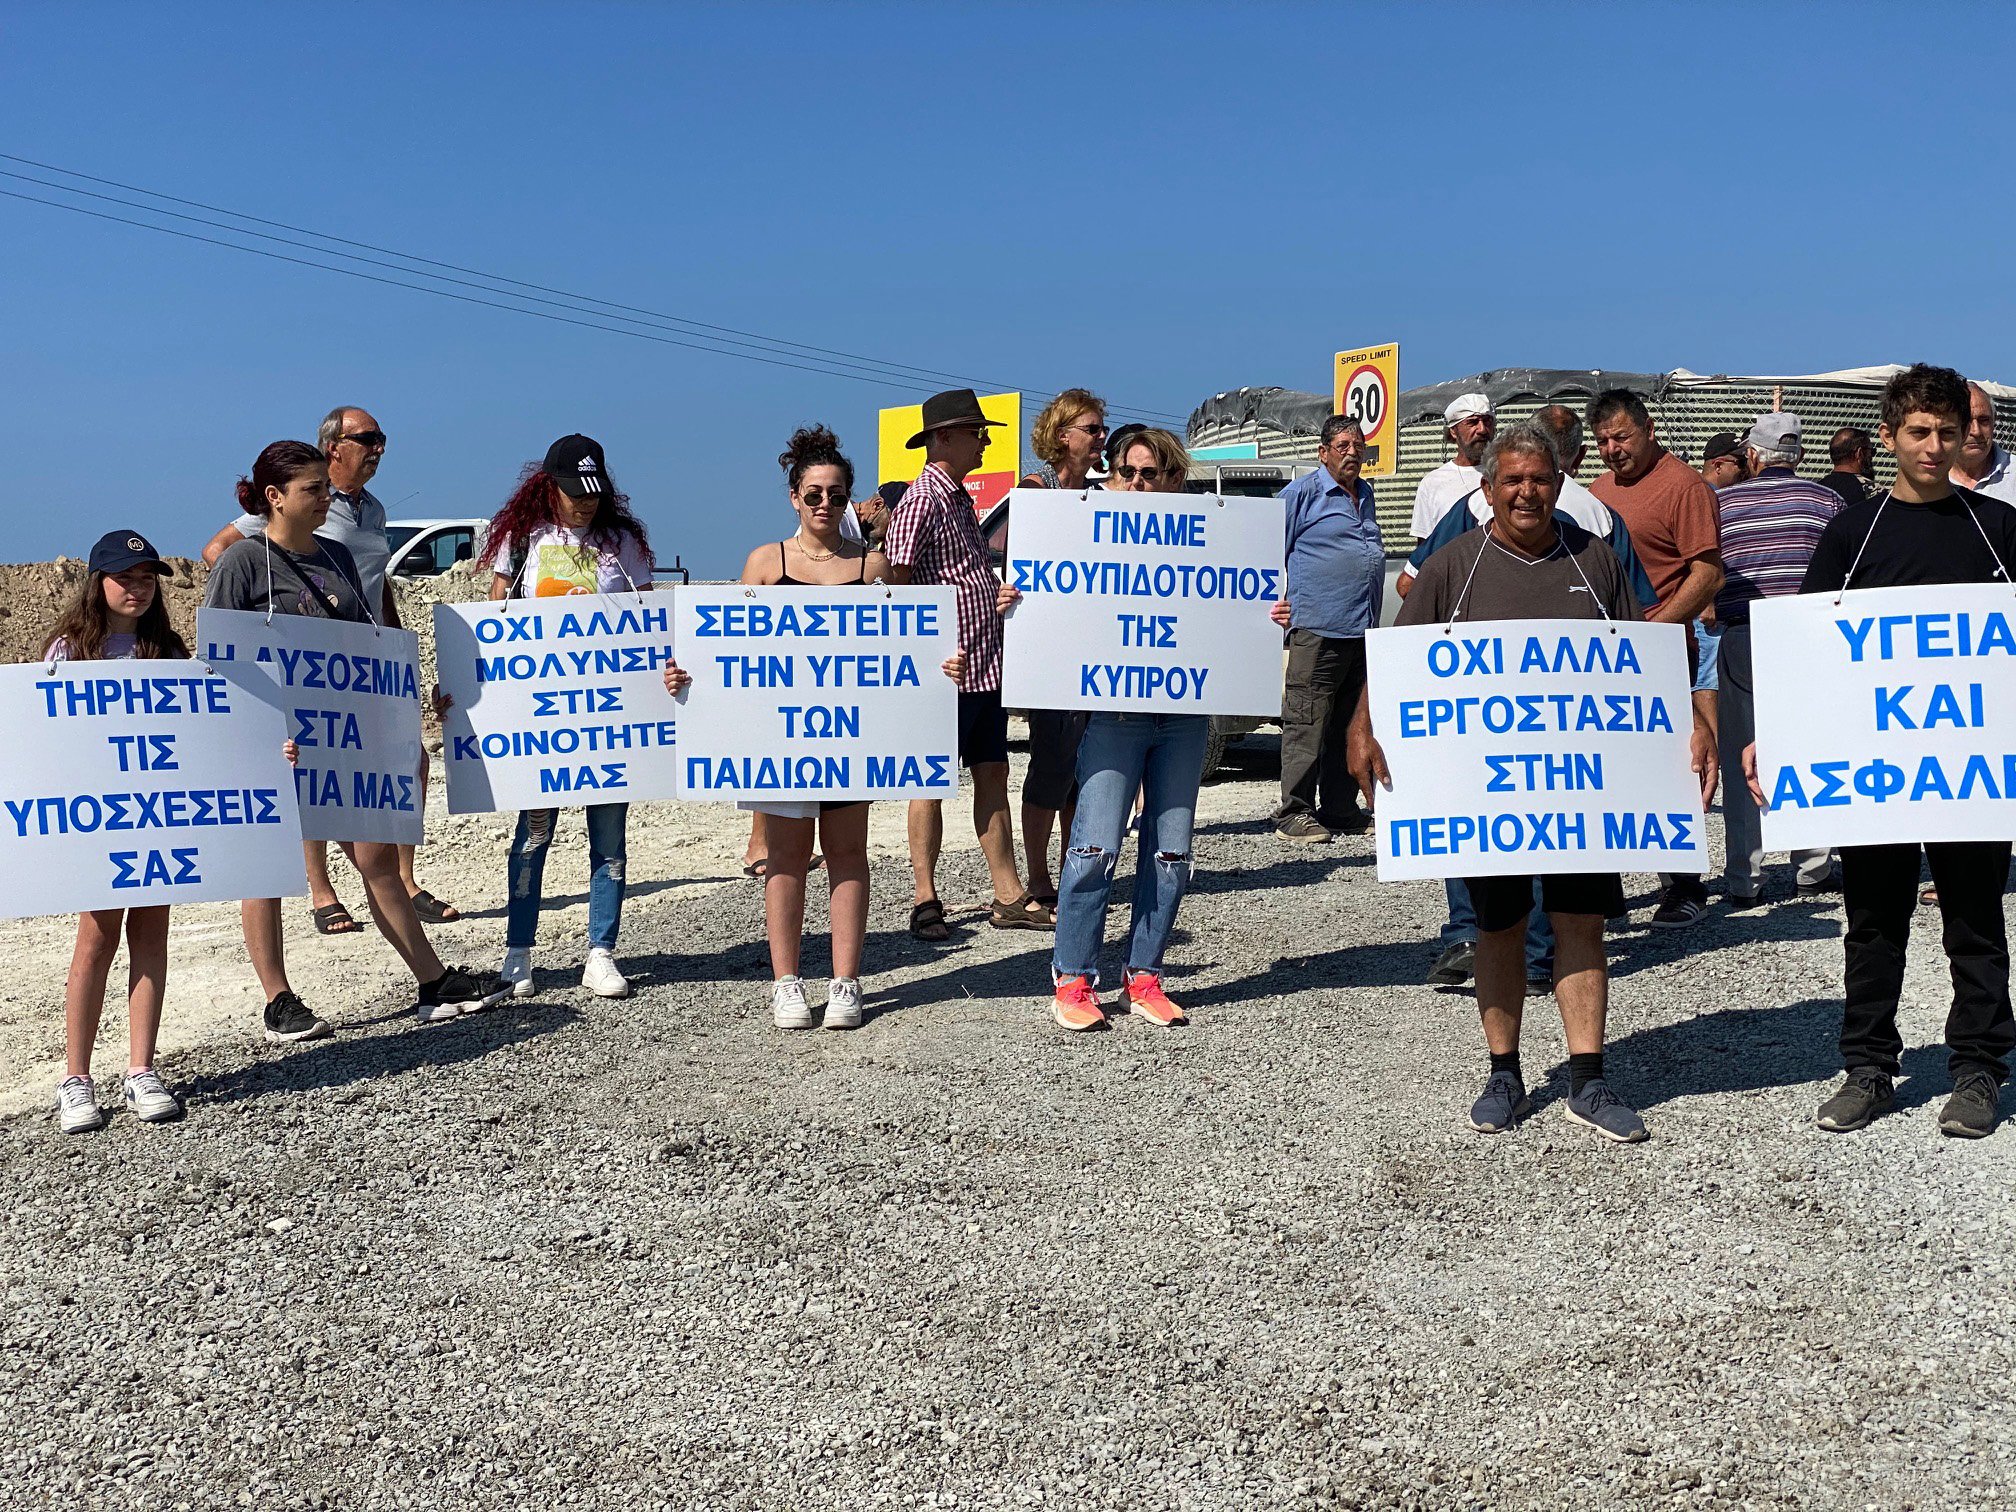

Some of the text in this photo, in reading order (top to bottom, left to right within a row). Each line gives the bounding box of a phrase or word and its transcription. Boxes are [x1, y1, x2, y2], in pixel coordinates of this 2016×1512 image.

[1341, 349, 1392, 365] SPEED LIMIT
[1350, 383, 1380, 424] 30
[1094, 511, 1206, 547] ΓΙΝΑΜΕ
[1013, 560, 1279, 601] ΣΚΟΥΠΙΔΟΤΟΠΟΣ
[475, 607, 668, 644] ΟΧΙ ΑΛΛΗ
[696, 604, 938, 637] ΣΕΒΑΣΤΕΙΤΕ
[1118, 614, 1178, 648] ΤΗΣ
[1835, 612, 2016, 662] ΥΓΕΙΑ
[475, 645, 673, 683] ΜΟΛΥΝΣΗ
[716, 655, 920, 688] ΤΗΝ ΥΓΕΙΑ
[1427, 636, 1642, 678] ΟΧΙ ΑΛΛΑ
[36, 678, 231, 718] ΤΗΡΗΣΤΕ
[1081, 664, 1209, 700] ΚΥΠΡΟΥ
[533, 687, 623, 717] ΣΤΙΣ
[1399, 694, 1673, 738] ΕΡΓΟΣΤΑΣΙΑ
[1875, 683, 1984, 731] ΚΑΙ
[294, 708, 363, 750] ΣΤΑ
[779, 706, 860, 738] ΤΩΝ
[108, 734, 179, 772] ΤΙΣ
[353, 771, 415, 812] ΜΑΣ
[541, 763, 628, 793] ΜΑΣ
[687, 756, 950, 790] ΠΑΙΔΙΩΝ ΜΑΣ
[1485, 753, 1603, 793] ΣΤΗΝ
[4, 788, 281, 837] ΥΠΟΣΧΕΣΕΙΣ
[1390, 812, 1696, 857] ΠΕΡΙΟΧΗ ΜΑΣ
[109, 847, 202, 888] ΣΑΣ
